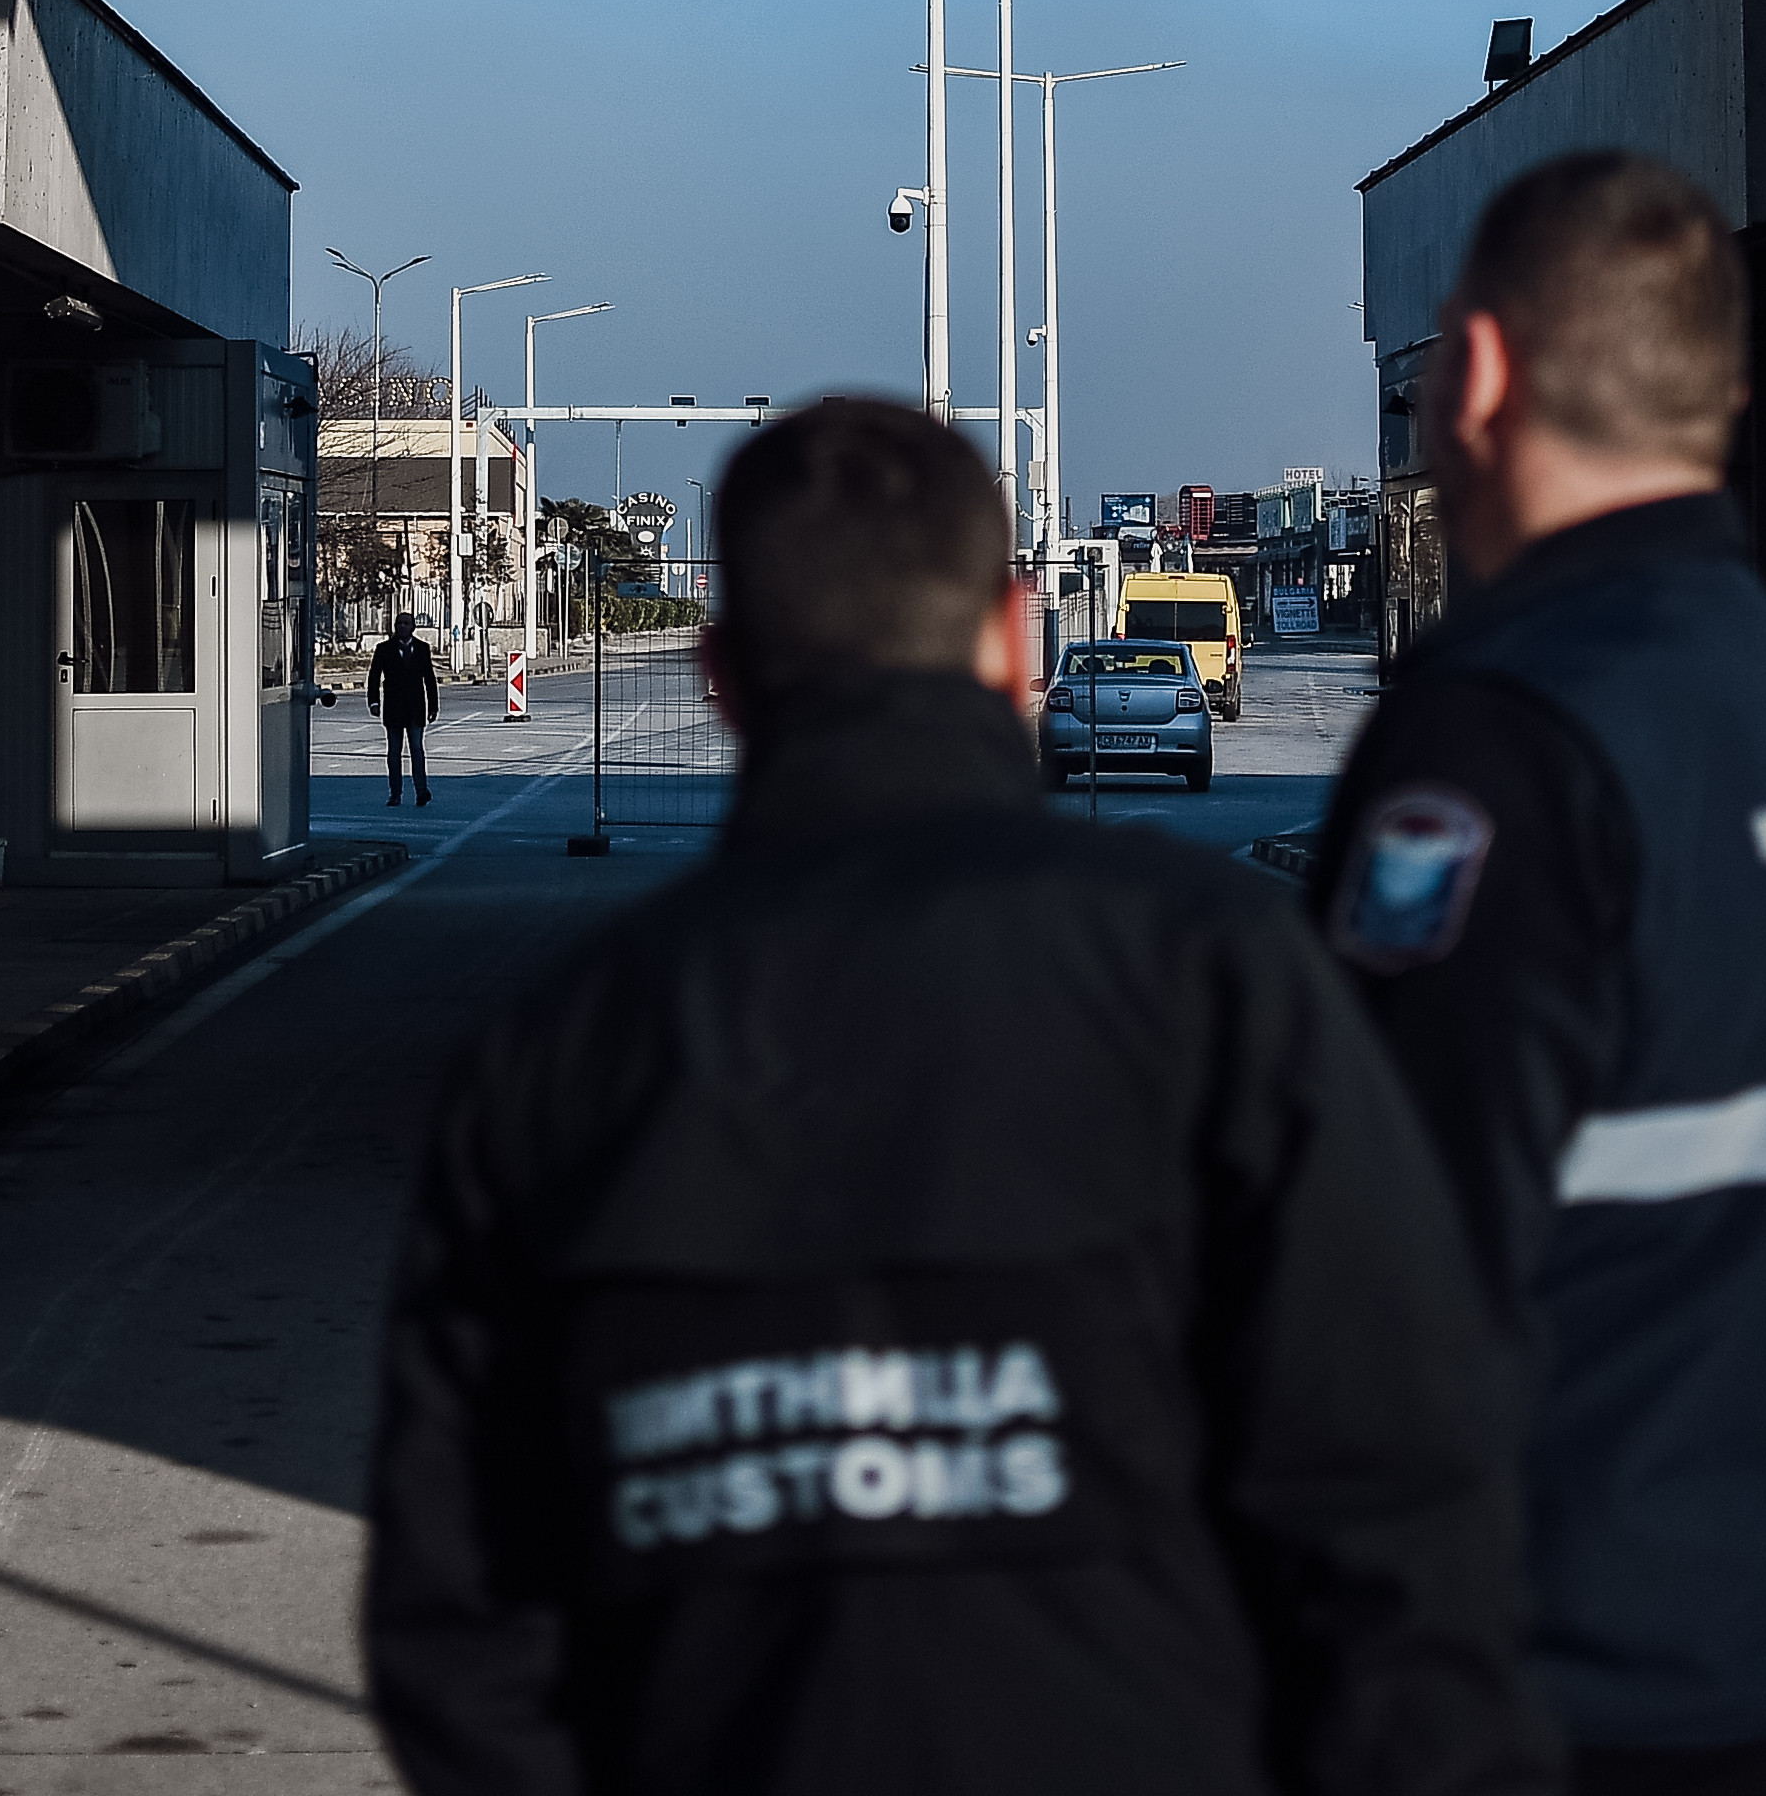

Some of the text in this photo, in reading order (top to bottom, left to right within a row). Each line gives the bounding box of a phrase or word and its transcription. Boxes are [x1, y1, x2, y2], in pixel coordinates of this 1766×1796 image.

[1285, 469, 1323, 480] HOTEL
[616, 492, 677, 516] CASINO
[626, 515, 666, 526] FINIX
[1274, 587, 1315, 596] BULGARIA
[1275, 608, 1317, 619] VIGNETTE
